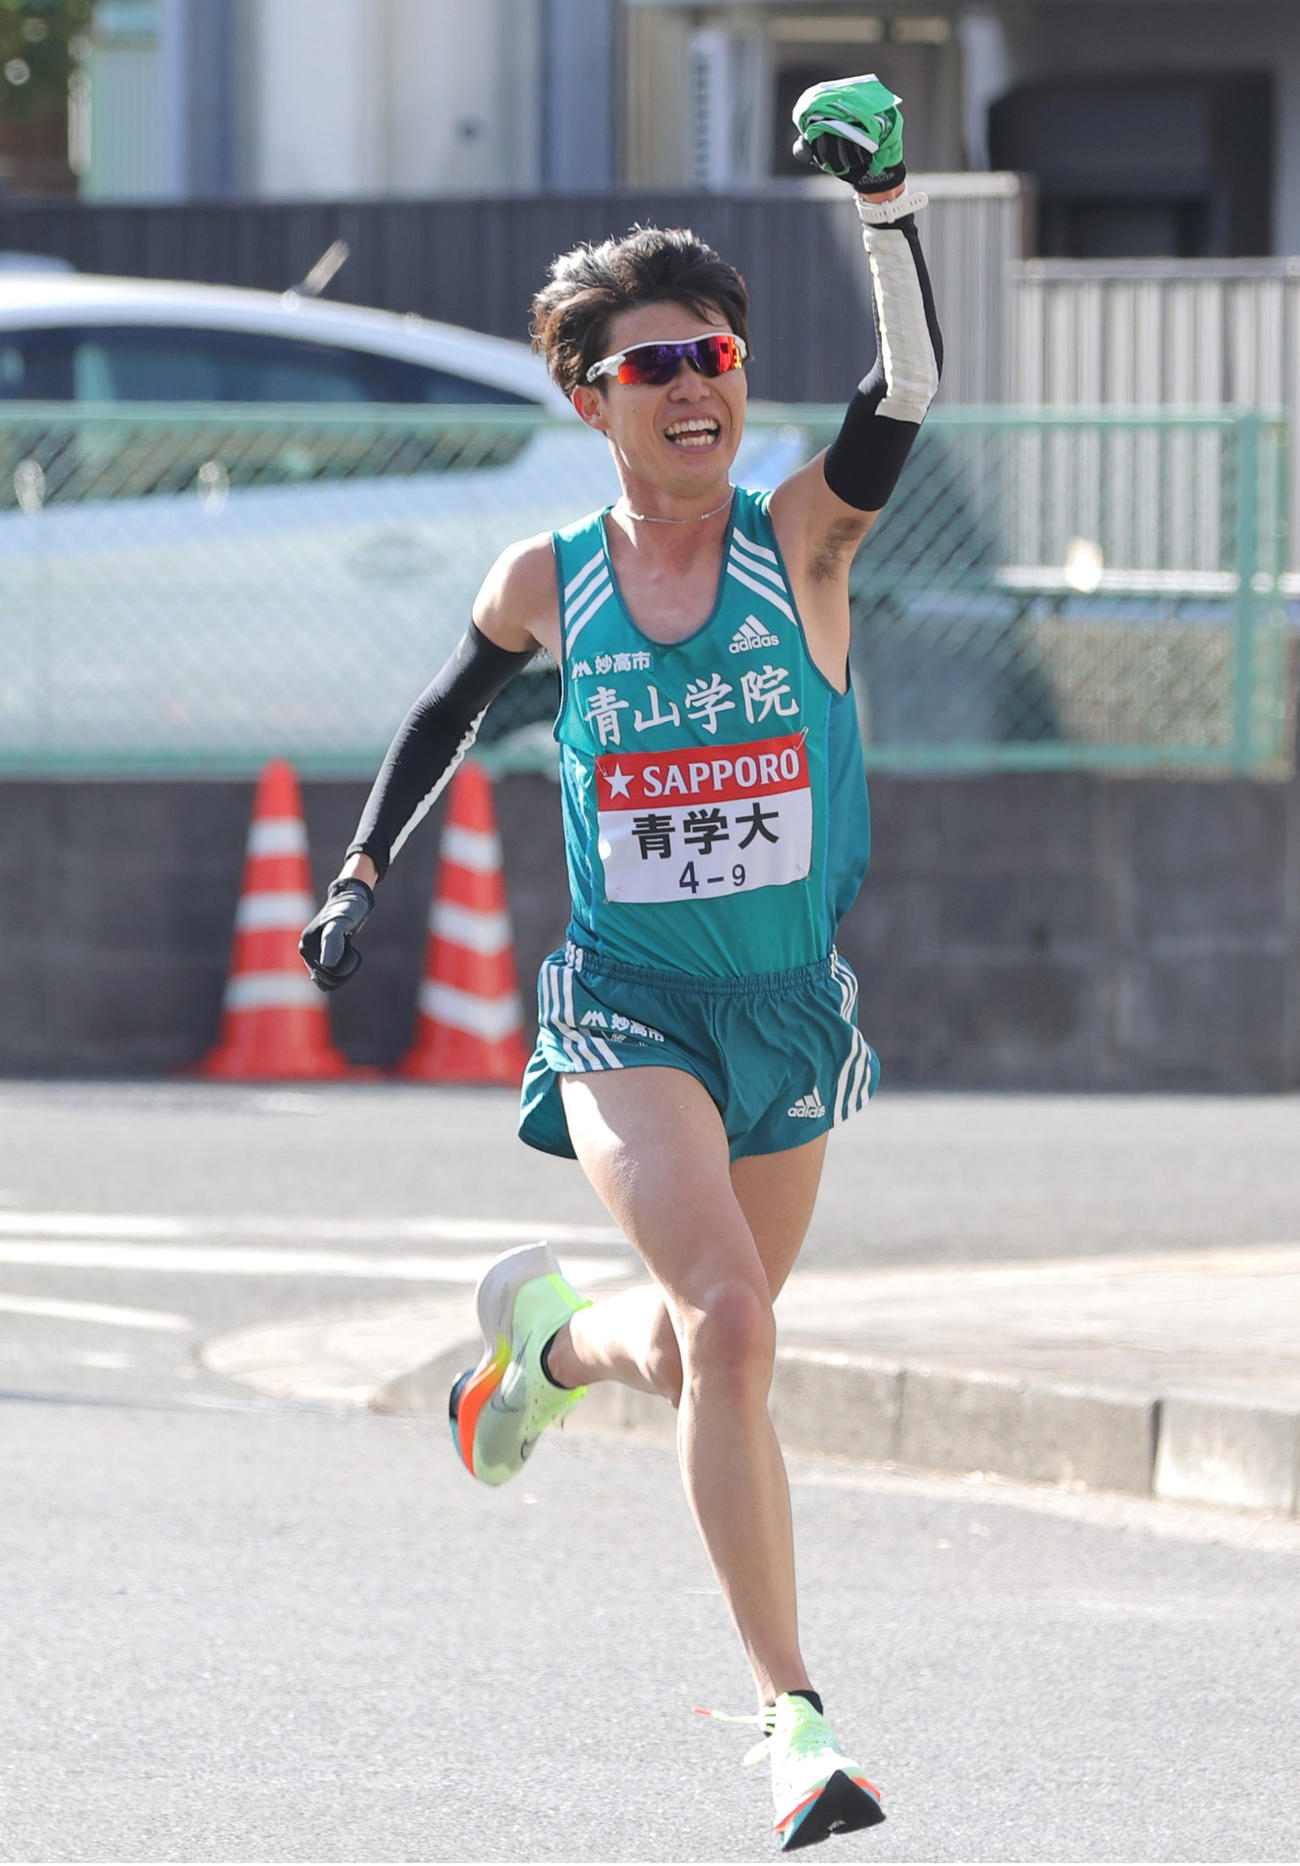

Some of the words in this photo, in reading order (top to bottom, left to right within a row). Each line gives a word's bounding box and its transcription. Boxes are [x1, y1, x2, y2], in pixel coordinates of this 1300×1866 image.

[729, 634, 780, 654] adidas
[595, 652, 651, 676] 妙高市
[584, 665, 800, 746] 青山学院
[642, 748, 800, 797] SAPPORO
[631, 803, 780, 860] 青学大
[787, 1104, 826, 1118] adids
